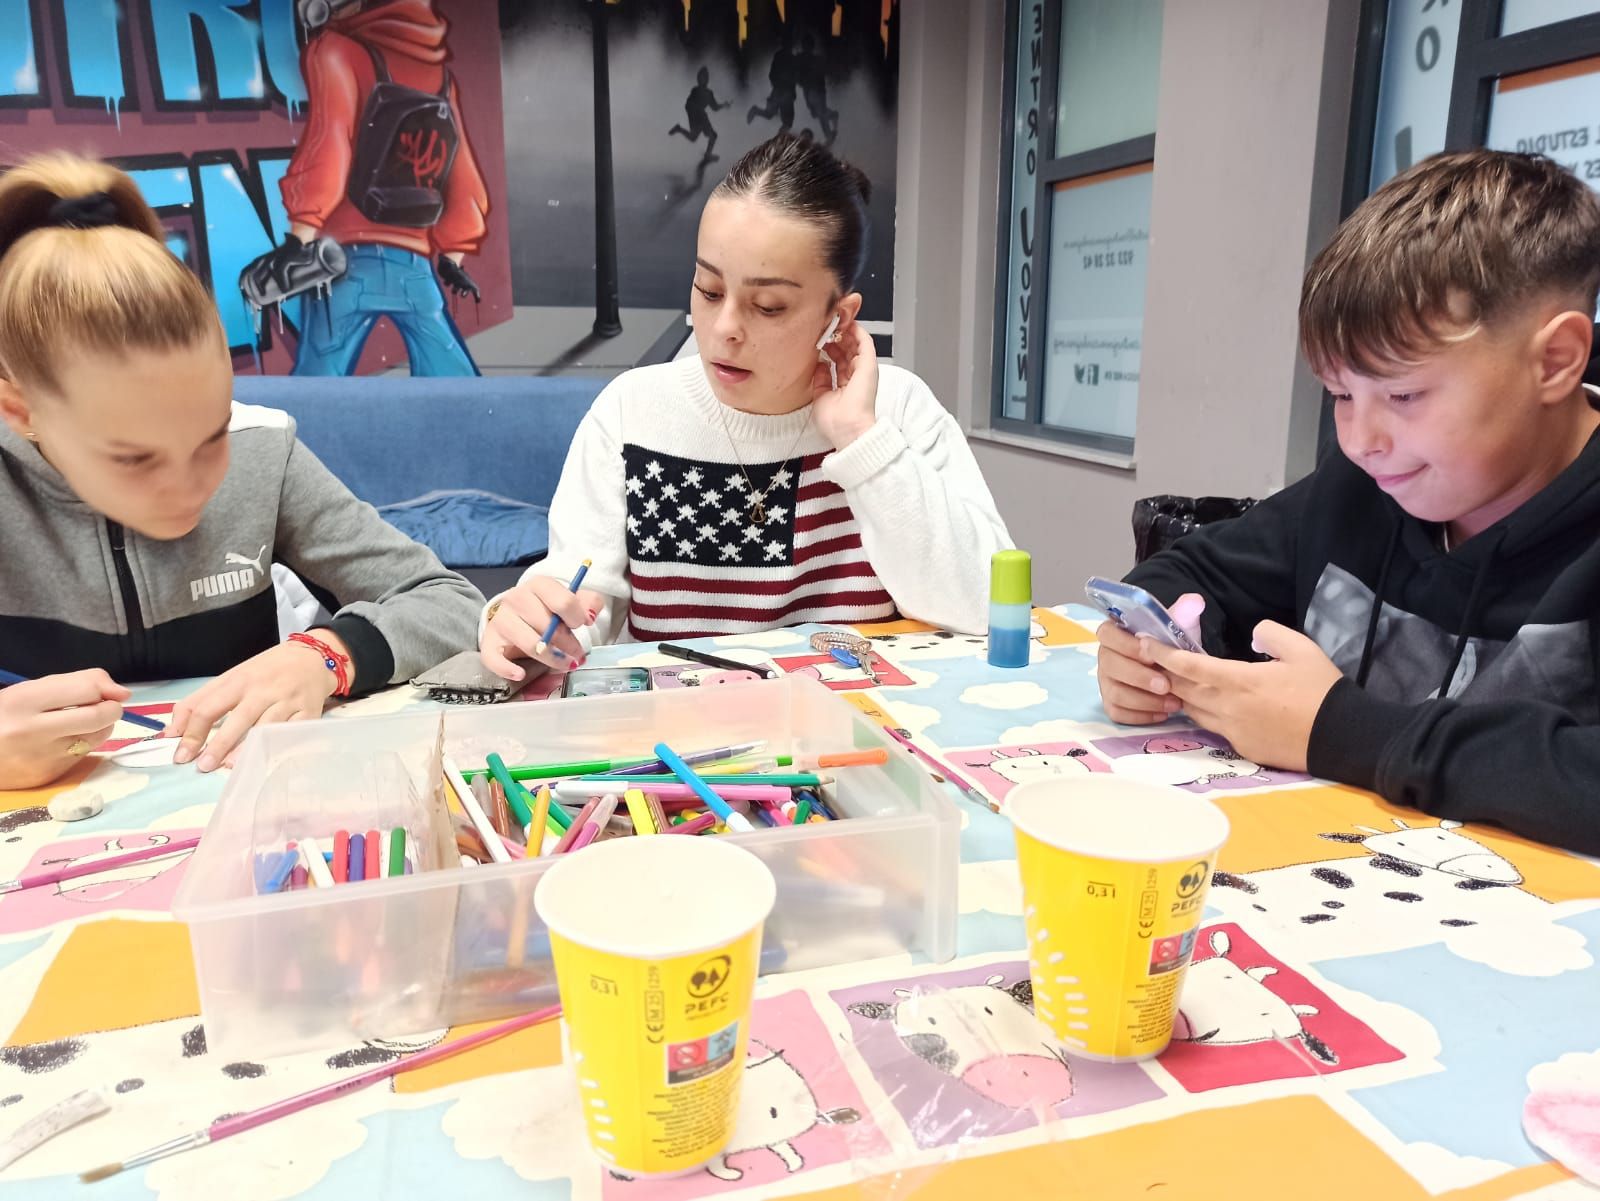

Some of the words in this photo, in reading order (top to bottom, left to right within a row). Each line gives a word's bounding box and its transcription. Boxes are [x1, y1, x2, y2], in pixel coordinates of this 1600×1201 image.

[190, 568, 255, 601] PUMA
[1171, 894, 1202, 912] PEFC
[684, 991, 729, 1014] PEFC
